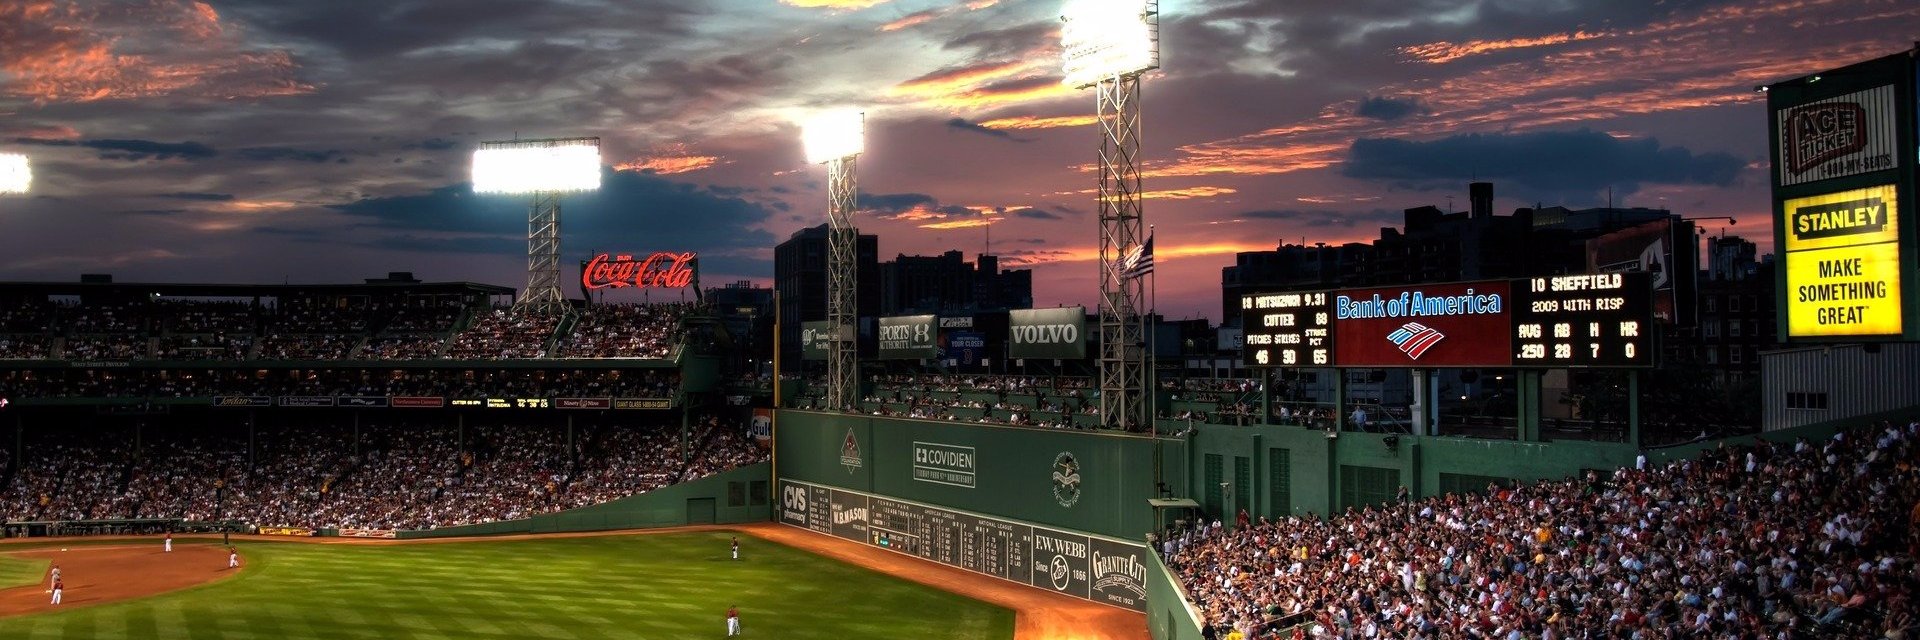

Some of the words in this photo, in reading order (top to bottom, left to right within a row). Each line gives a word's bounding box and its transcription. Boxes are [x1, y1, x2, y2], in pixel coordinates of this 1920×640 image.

[1799, 109, 1856, 140] ACE
[1800, 131, 1856, 164] TICKET
[1799, 206, 1879, 233] STANLEY
[583, 252, 696, 289] Coca-Cola
[1819, 258, 1862, 278] MAKE
[1532, 278, 1545, 292] 10
[1551, 273, 1622, 291] SHEFFIELD
[1243, 297, 1252, 309] 18
[1256, 295, 1301, 308] MATSUZAKA
[1304, 293, 1325, 306] 9.31
[1799, 281, 1886, 303] SOMETHING
[1337, 294, 1385, 319] Bank
[1387, 292, 1408, 317] of
[1410, 288, 1501, 316] America
[1532, 300, 1558, 312] 2009
[1563, 299, 1591, 311] WITH
[1596, 298, 1624, 310] RISP
[1264, 314, 1295, 326] CUTTER
[1315, 312, 1327, 325] 88
[879, 325, 910, 341] SPORTS
[1011, 324, 1078, 344] VOLVO
[1305, 328, 1327, 337] STRIKE
[1518, 324, 1541, 338] AVG
[1554, 323, 1570, 338] AB
[1590, 322, 1599, 337] H
[1620, 321, 1638, 336] HR
[951, 340, 964, 348] YOUR
[965, 340, 984, 348] CLOSER
[1247, 334, 1272, 344] PITCHES
[1274, 334, 1300, 344] STRIKES
[1309, 338, 1322, 346] PCT
[1256, 349, 1269, 364] 46
[1283, 349, 1296, 364] 30
[1313, 349, 1327, 364] 65
[1517, 344, 1545, 359] .250
[1555, 343, 1571, 359] 28
[1590, 343, 1599, 358] 7
[1625, 343, 1635, 358] 0
[928, 449, 972, 468] COVIDIEN
[784, 485, 806, 511] CVS
[784, 509, 806, 525] pharmacy
[978, 520, 996, 528] NATIONAL
[1054, 539, 1086, 559] WEBB
[1035, 561, 1048, 573] Since
[1073, 569, 1086, 582] 1866
[1092, 550, 1129, 580] GRANITE
[1108, 594, 1122, 603] SINCE
[1122, 597, 1134, 606] 1923
